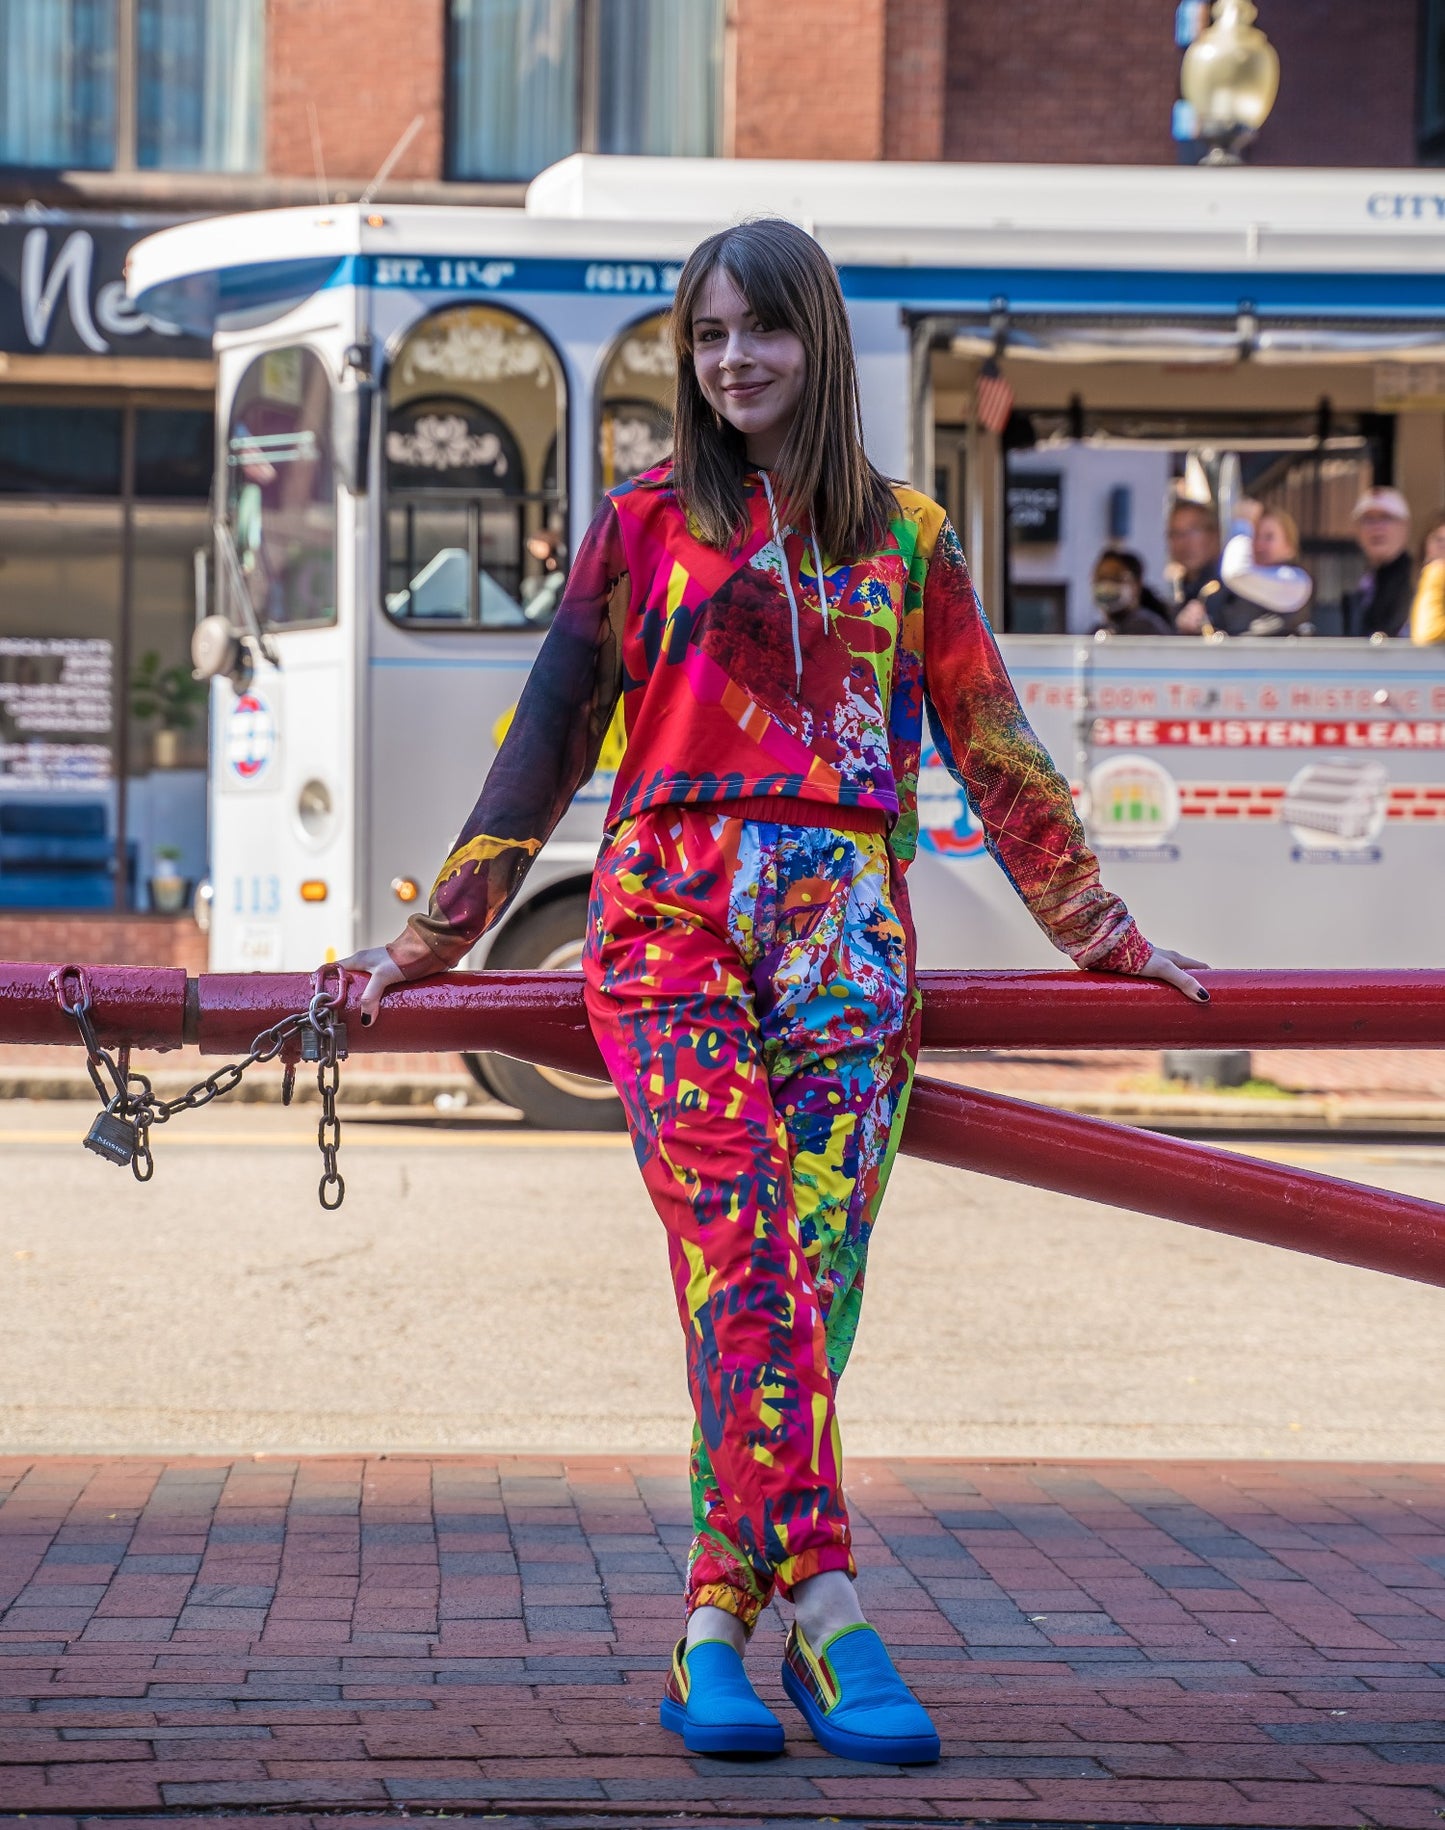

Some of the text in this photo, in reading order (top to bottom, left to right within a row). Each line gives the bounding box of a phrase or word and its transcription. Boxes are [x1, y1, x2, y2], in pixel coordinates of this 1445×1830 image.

[1093, 718, 1445, 748] SEE LISTEN LEAR
[233, 875, 282, 914] 113
[96, 1135, 128, 1157] Master
